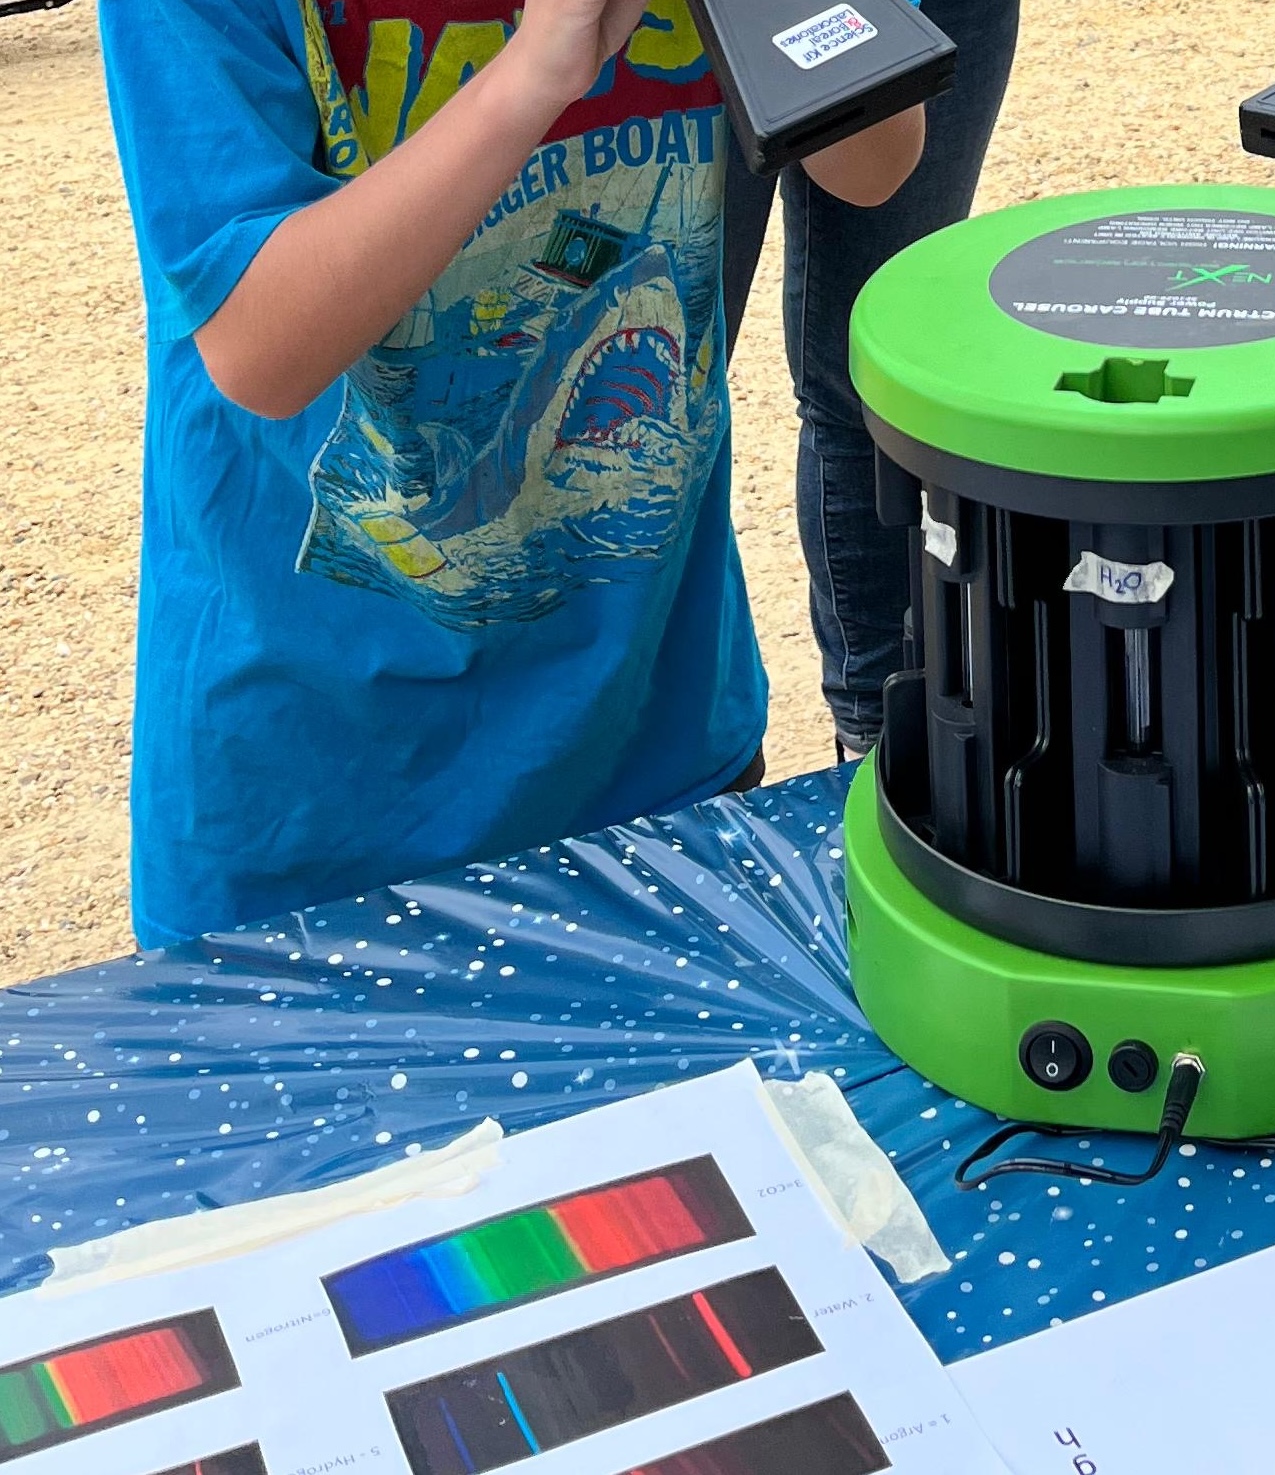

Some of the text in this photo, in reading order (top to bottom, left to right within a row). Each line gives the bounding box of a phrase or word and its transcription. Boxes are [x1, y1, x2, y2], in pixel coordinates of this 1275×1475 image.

[780, 8, 856, 48] Laboratories
[808, 22, 851, 47] Boreal
[821, 23, 874, 52] Science
[583, 103, 724, 177] BOAT
[1012, 300, 1129, 316] CAROUSEL
[1134, 305, 1191, 318] TUBE
[1099, 560, 1143, 594] H2O
[813, 1298, 858, 1318] Water
[879, 1422, 923, 1445] Argon
[1053, 1426, 1082, 1449] h
